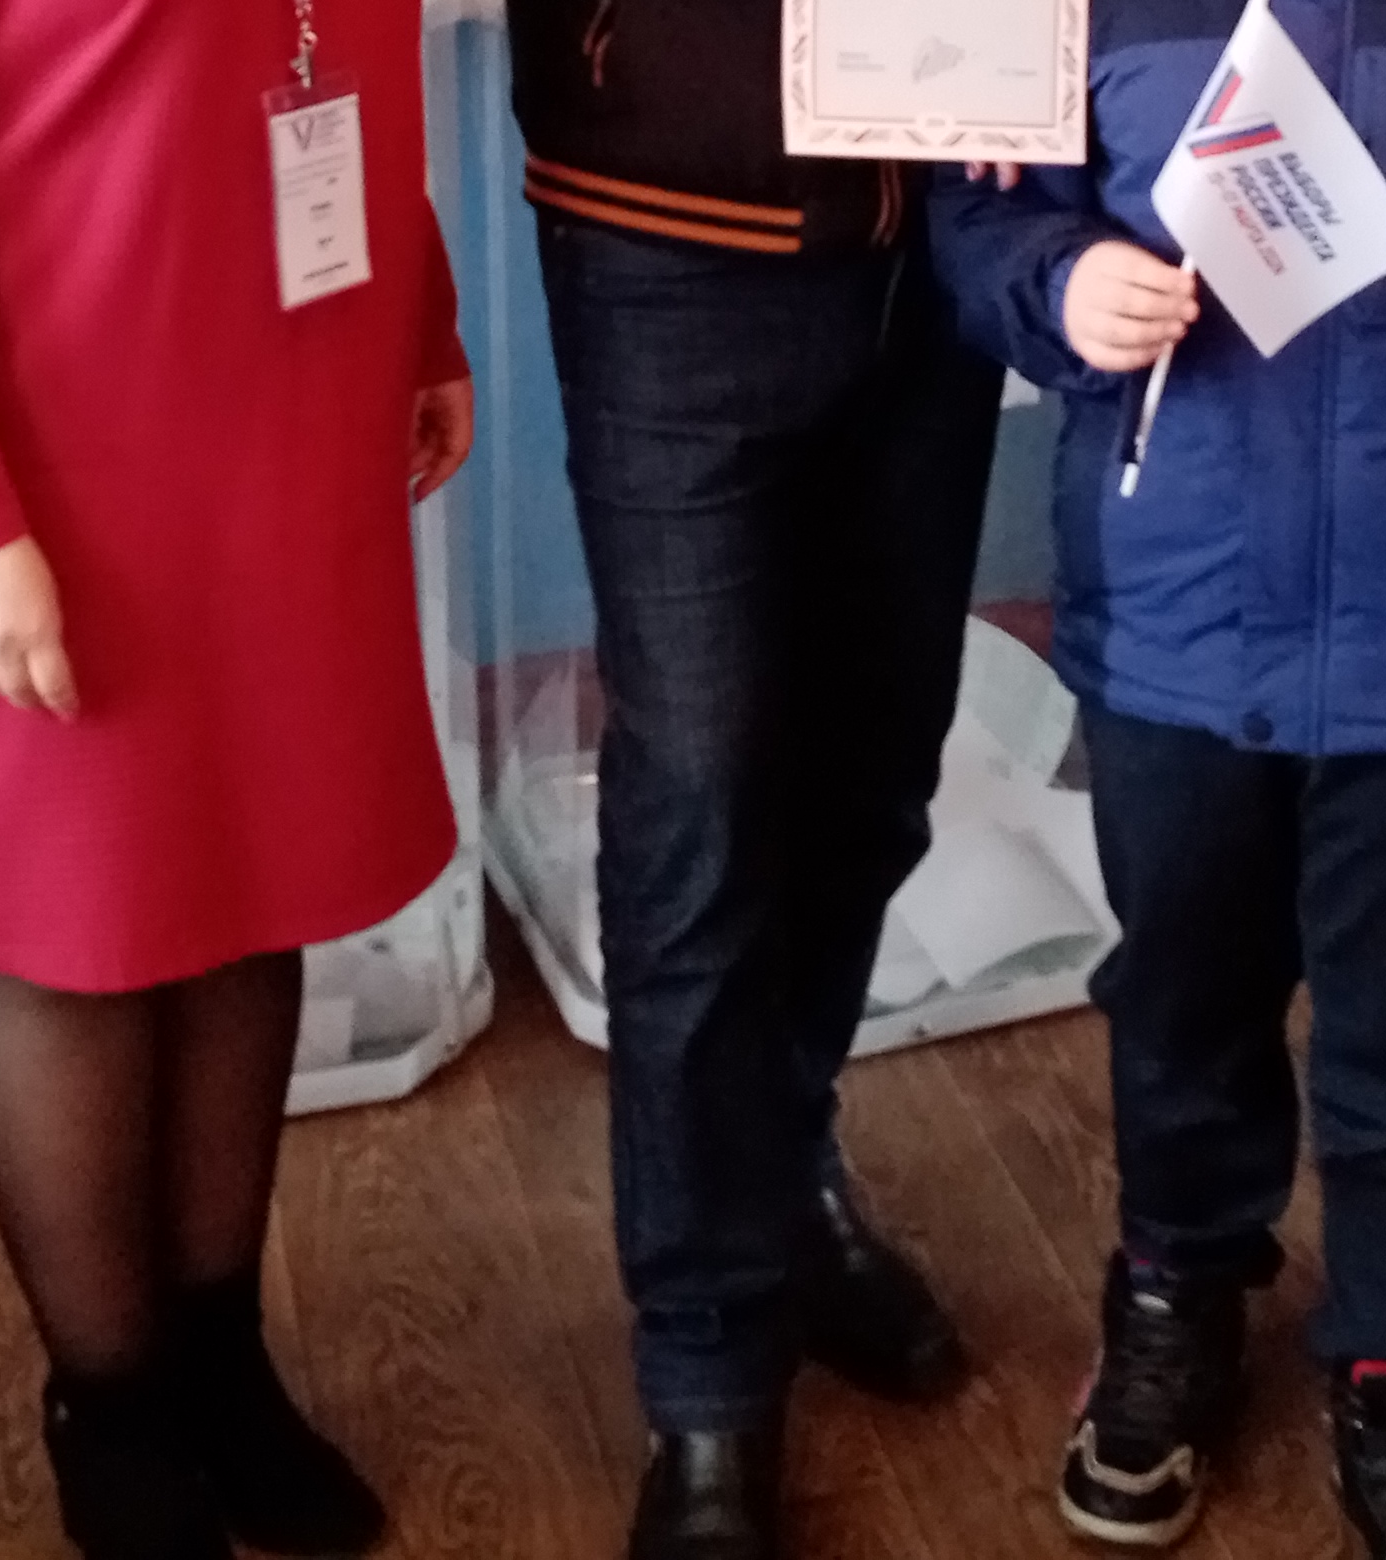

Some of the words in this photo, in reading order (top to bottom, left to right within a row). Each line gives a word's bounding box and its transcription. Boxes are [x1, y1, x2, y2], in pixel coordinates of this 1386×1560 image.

[1227, 164, 1286, 232] РОССИИ
[1251, 157, 1337, 264] ПРЕЗИДЕНТА
[1276, 150, 1344, 227] ВЫБОРЫ
